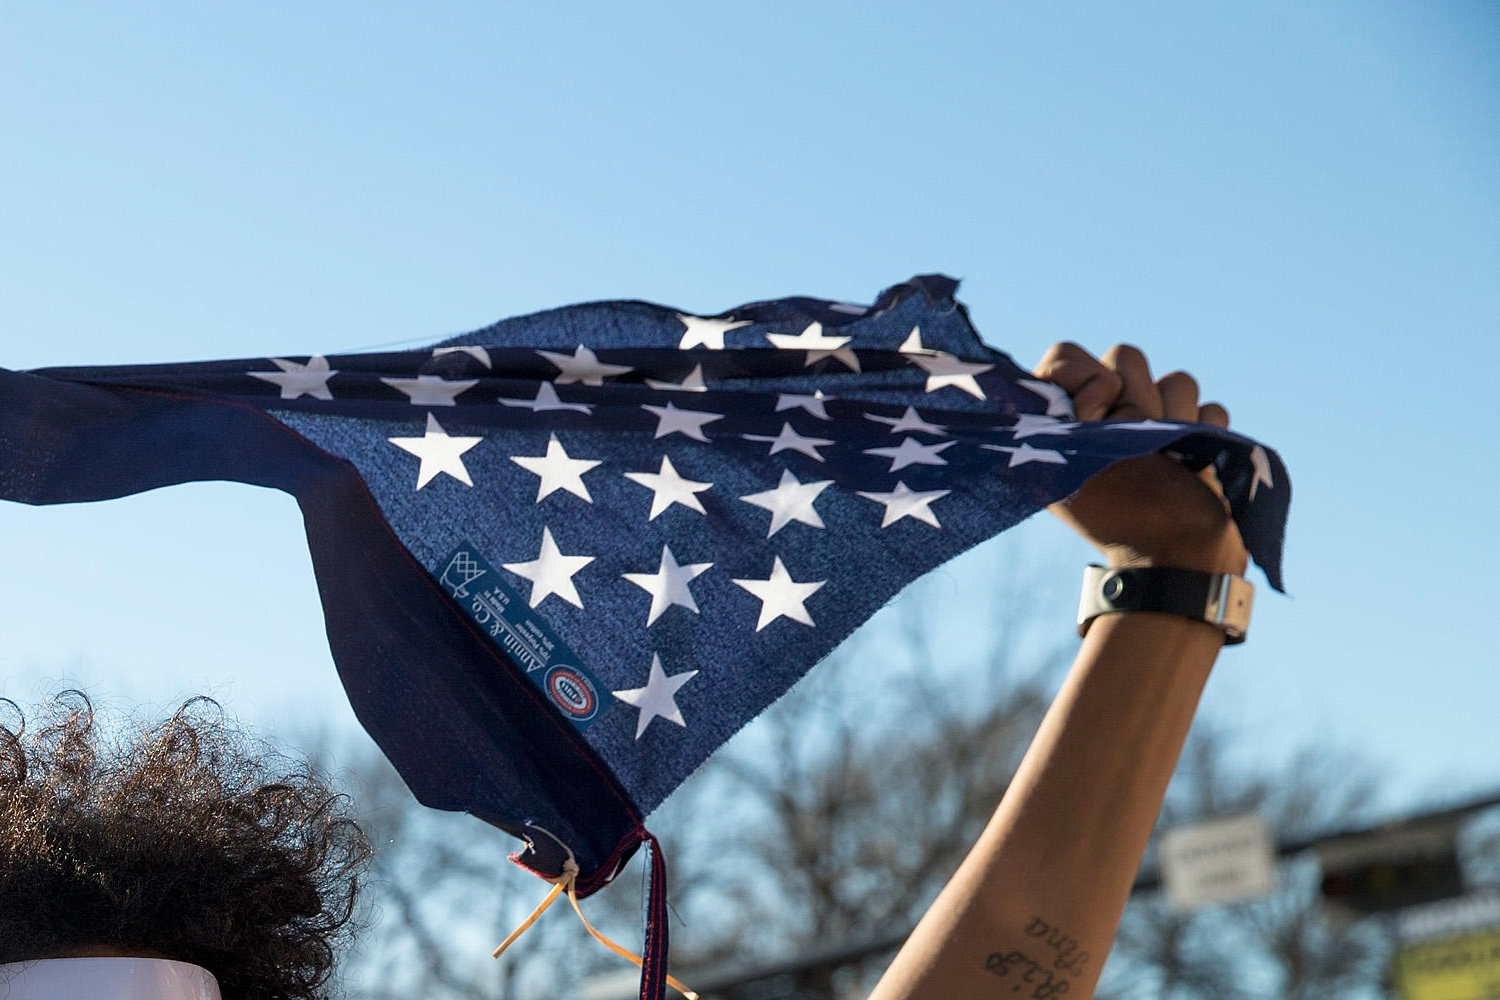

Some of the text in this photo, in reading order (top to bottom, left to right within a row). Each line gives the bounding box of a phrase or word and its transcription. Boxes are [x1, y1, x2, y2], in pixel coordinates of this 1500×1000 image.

[471, 596, 542, 673] Annin & Co.
